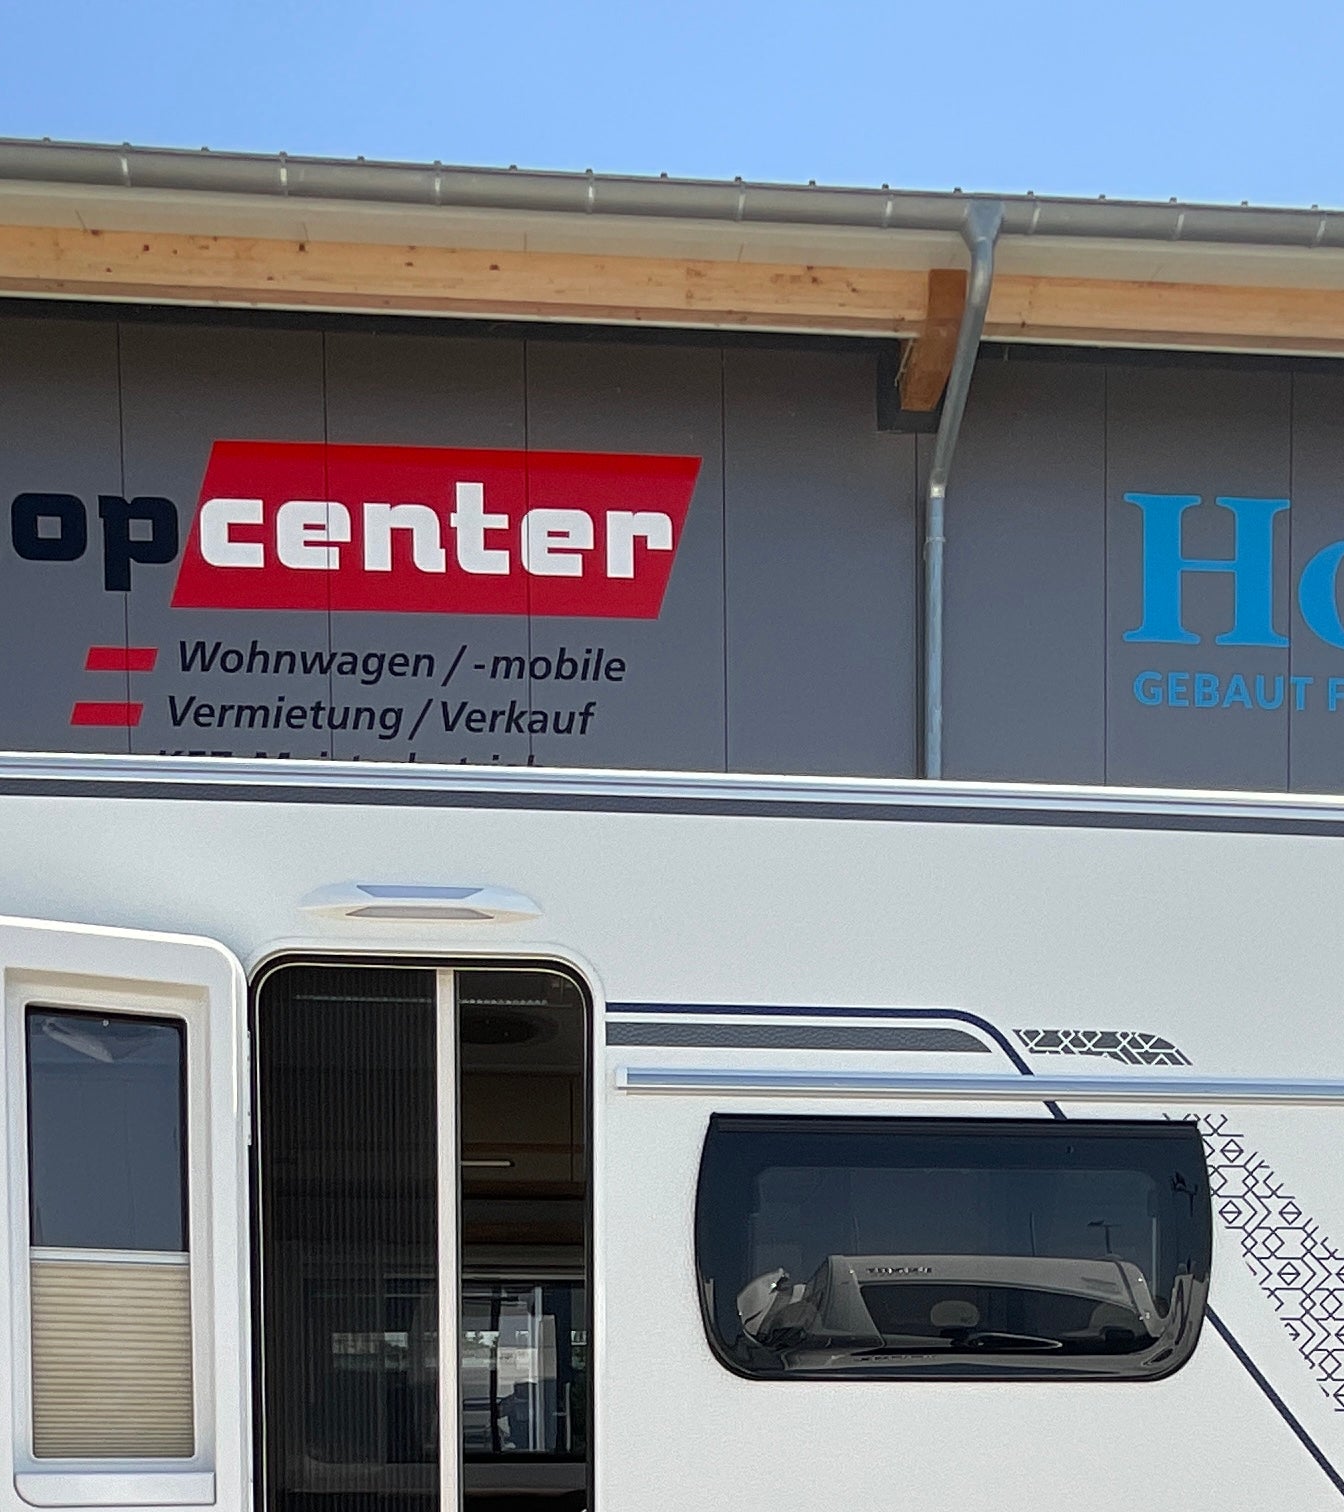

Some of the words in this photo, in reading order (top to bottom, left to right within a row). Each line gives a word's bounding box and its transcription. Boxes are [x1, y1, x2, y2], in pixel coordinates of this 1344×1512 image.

[178, 640, 436, 685] Wohnwagen
[1133, 670, 1315, 711] GEBAUT
[167, 696, 404, 741] Vermietung
[441, 702, 597, 736] Verkauf
